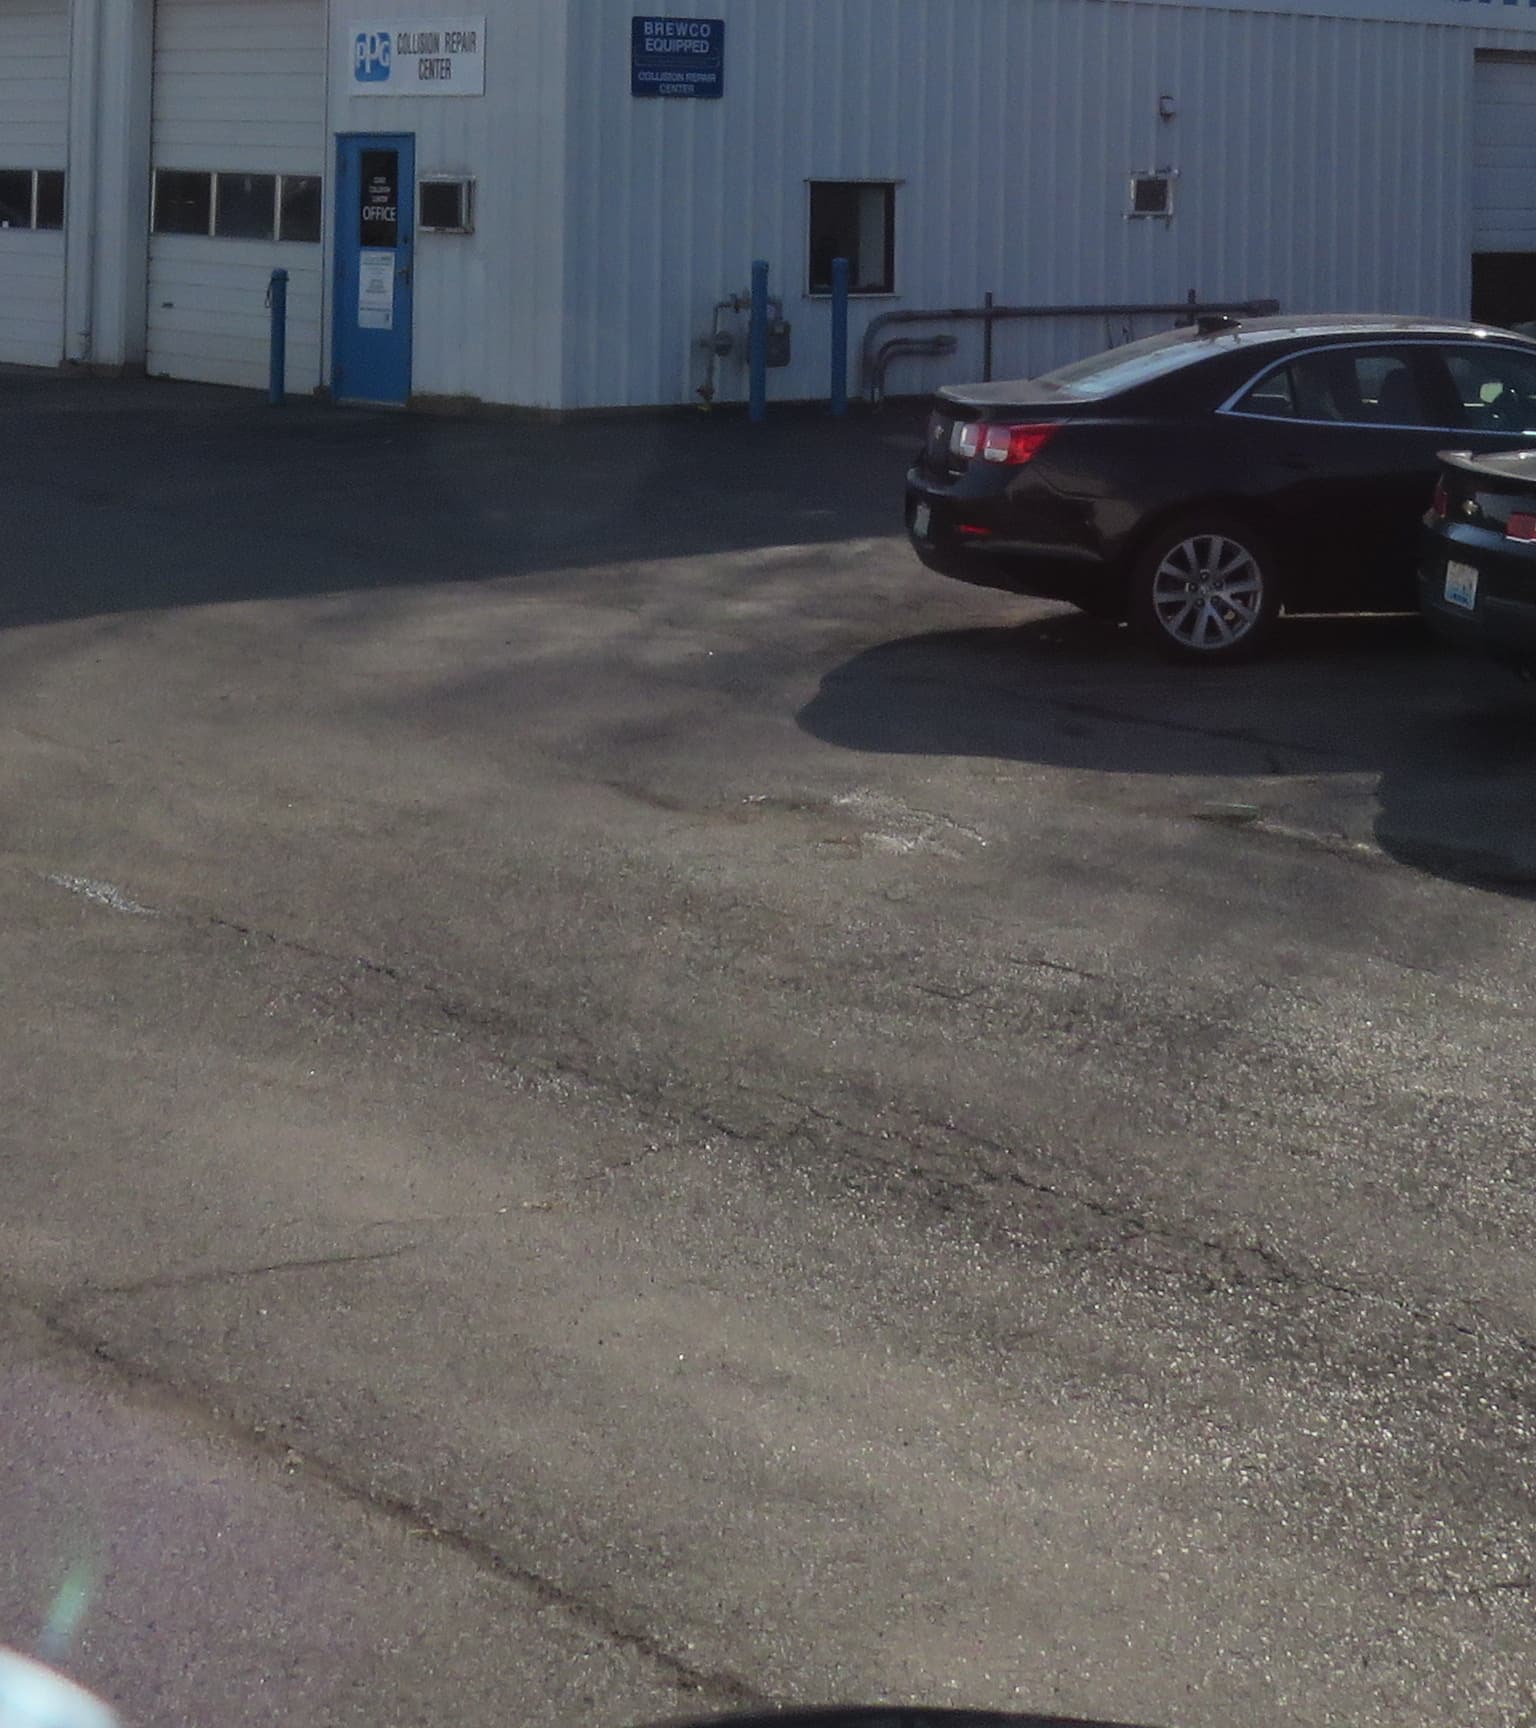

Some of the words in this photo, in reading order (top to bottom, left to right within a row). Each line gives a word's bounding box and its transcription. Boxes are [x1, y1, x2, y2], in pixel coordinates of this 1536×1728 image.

[644, 21, 711, 38] BREWCO
[356, 31, 390, 74] PPG
[396, 32, 441, 55] COLLISION
[444, 31, 477, 54] REPAIR
[645, 38, 710, 53] EQUIPPED
[418, 58, 452, 80] CENTER
[362, 206, 397, 222] OFFICE
